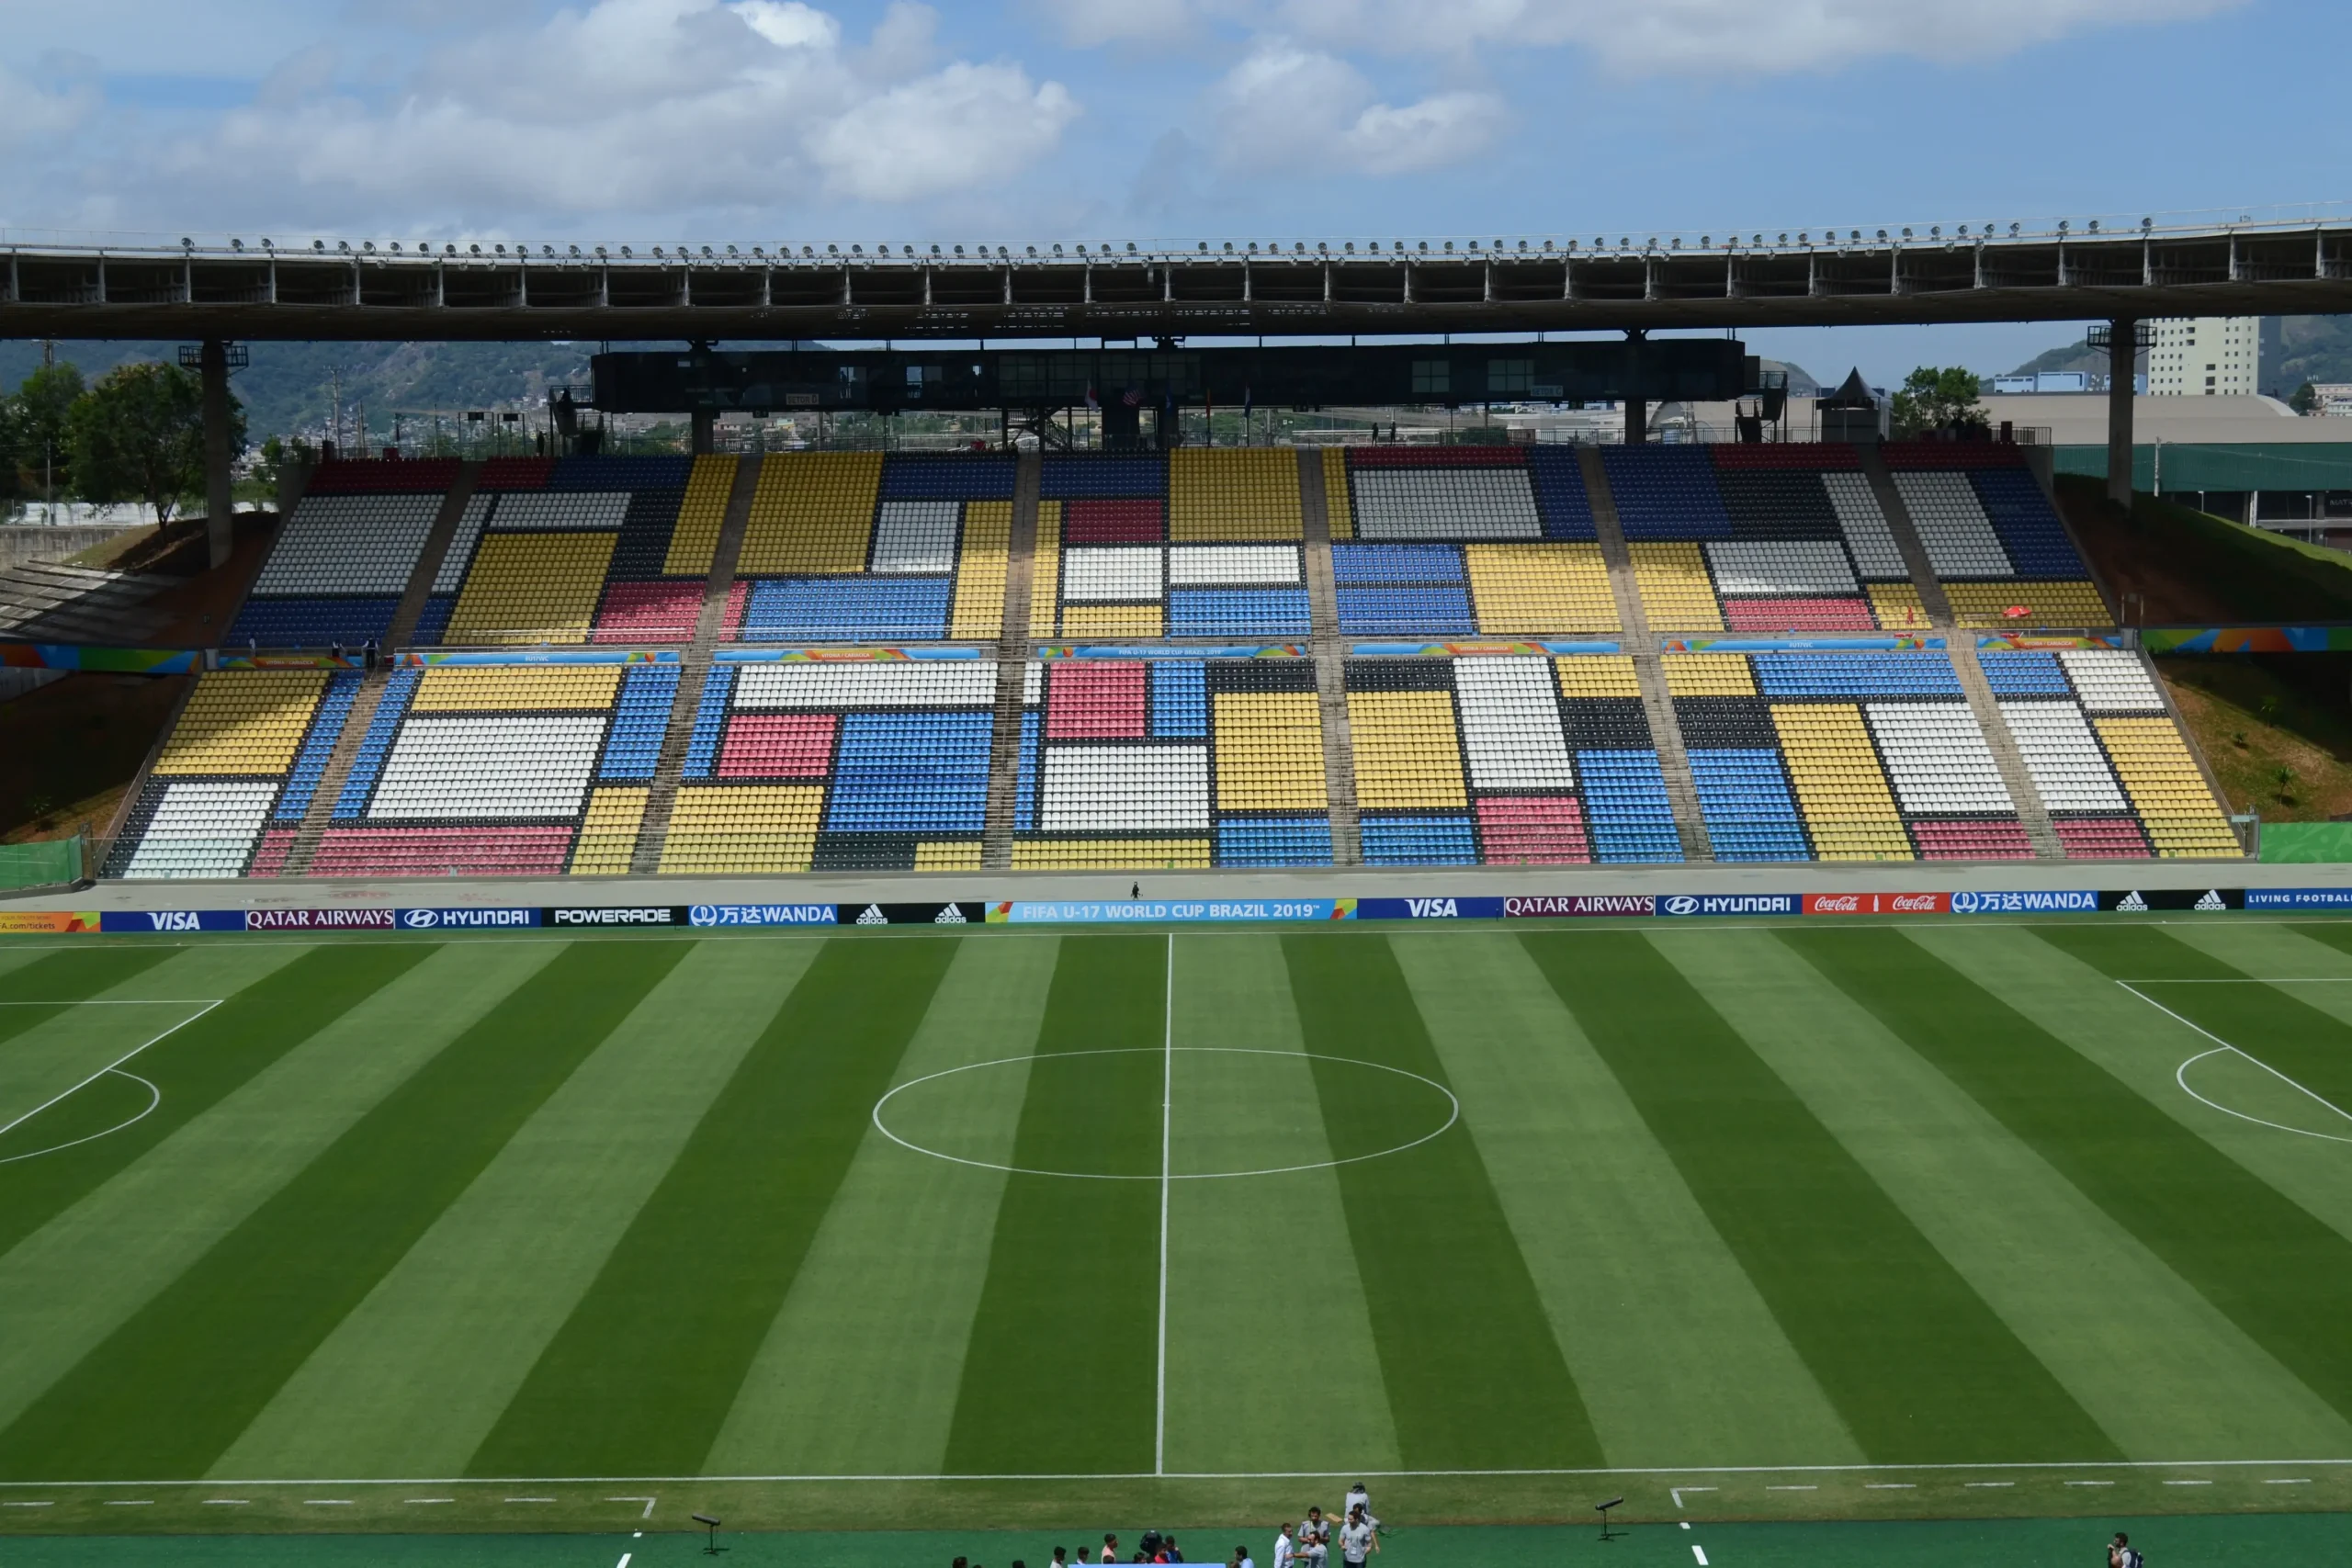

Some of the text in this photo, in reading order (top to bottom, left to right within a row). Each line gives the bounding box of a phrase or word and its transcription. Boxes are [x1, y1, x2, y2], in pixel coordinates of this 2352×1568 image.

[787, 396, 810, 404] SETOR
[1505, 897, 1654, 915] QATAR AIRWAYS
[1703, 897, 1791, 912] HYUNDAI
[1815, 897, 1860, 911] Coca-Cola
[1892, 896, 1937, 910] Coca-Cola
[2248, 895, 2290, 903] LIVING
[1022, 905, 1057, 919] FIFA
[1063, 905, 1101, 919] U-17
[1104, 905, 1167, 918] WORLD
[1171, 904, 1204, 918] CUP
[1209, 904, 1269, 917] BRAZIL
[1404, 898, 1458, 917] VISA
[2116, 903, 2148, 911] adidas
[2194, 902, 2226, 911] adidas
[146, 912, 201, 931] VISA
[247, 910, 394, 929] QATAR AIRWAYS
[443, 910, 529, 926] HYUNDAI
[554, 909, 671, 924] POWERADE
[856, 917, 888, 925] adidas
[934, 916, 967, 924] adidas
